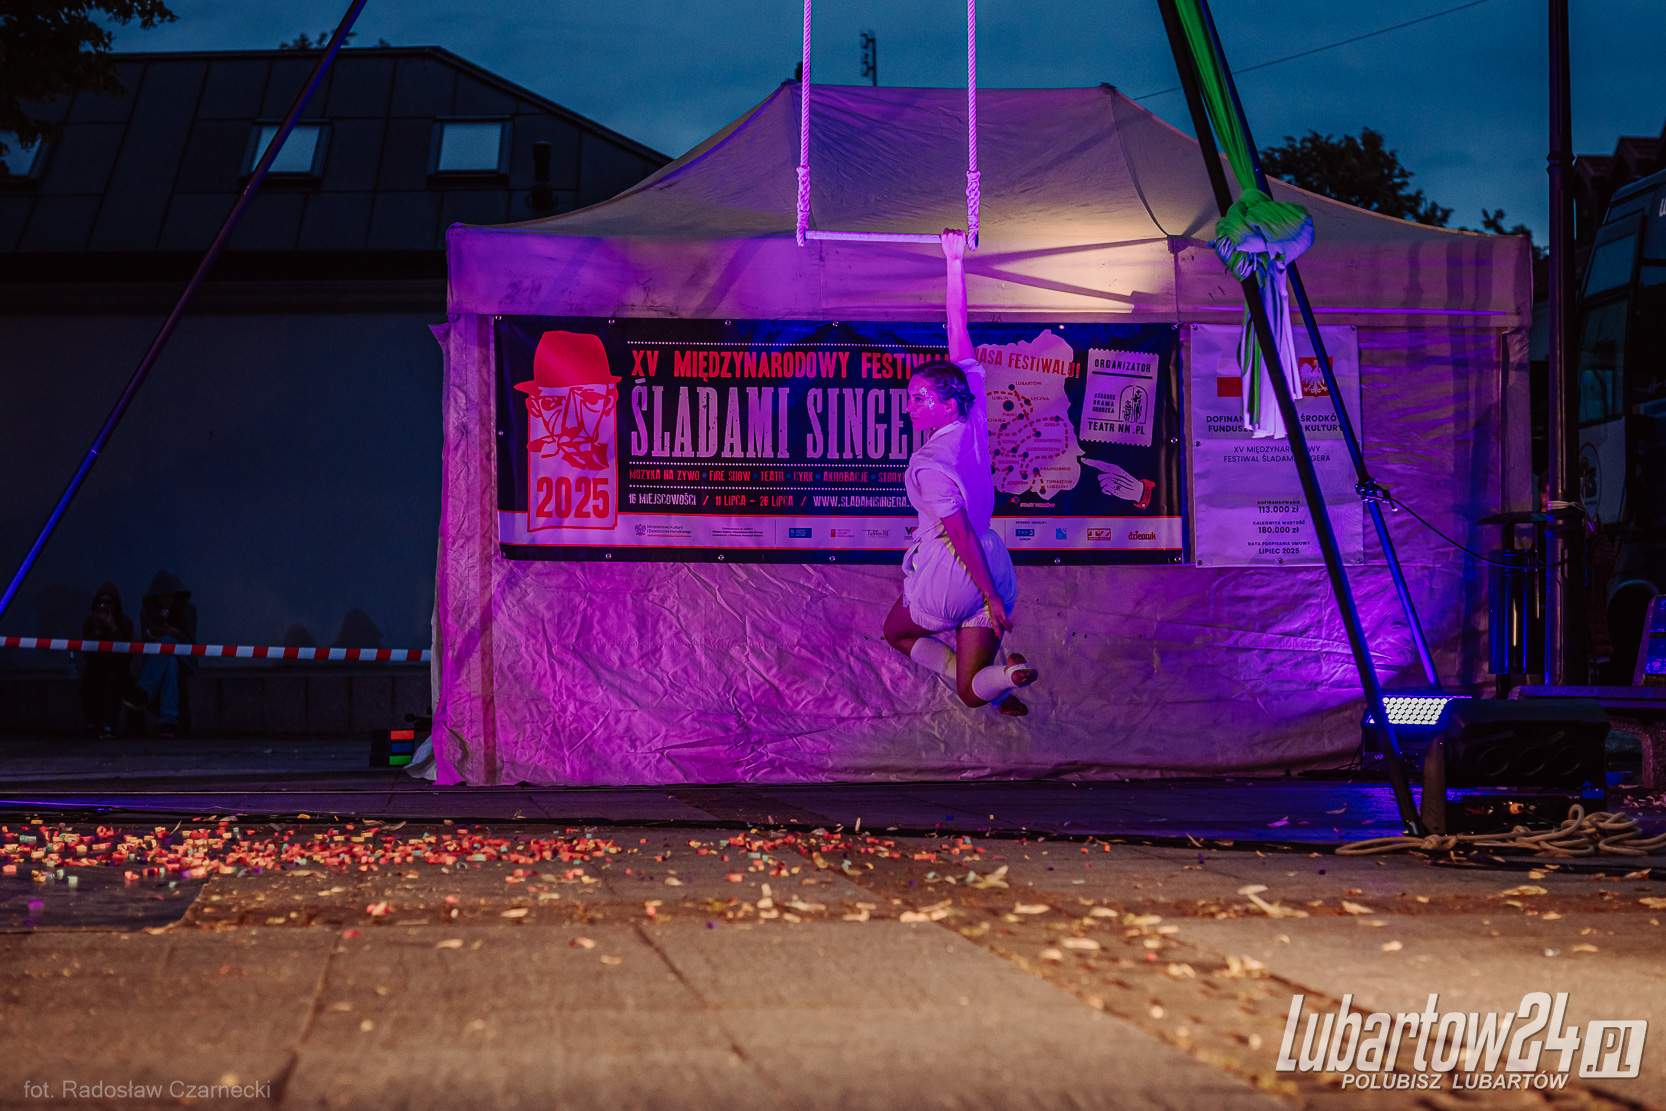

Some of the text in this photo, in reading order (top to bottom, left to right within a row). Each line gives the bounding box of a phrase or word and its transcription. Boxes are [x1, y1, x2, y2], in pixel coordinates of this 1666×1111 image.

[631, 350, 659, 378] XV
[673, 351, 849, 382] MIĘDZYNARODOWY
[1094, 358, 1151, 373] ORGANIZATOR
[631, 377, 935, 460] ŚLADAMI SINGE
[1300, 412, 1337, 422] ŚRODKÓ
[1088, 421, 1115, 433] TEATR
[1233, 445, 1321, 455] XV MIĘDZYNARWY
[1223, 455, 1259, 463] FESTIWAL
[1261, 453, 1294, 463] ŚLADAM
[629, 469, 661, 481] MUZYKA
[663, 470, 675, 481] NA
[536, 476, 610, 519] 2025
[639, 492, 697, 506] MIEJSCOWOŚCI
[724, 496, 747, 507] LIPCA
[771, 496, 794, 507] LIPCA
[813, 495, 910, 508] WWW.SLADAMISINGERA.
[1259, 505, 1290, 513] 113.000
[1258, 526, 1290, 534] 180.000
